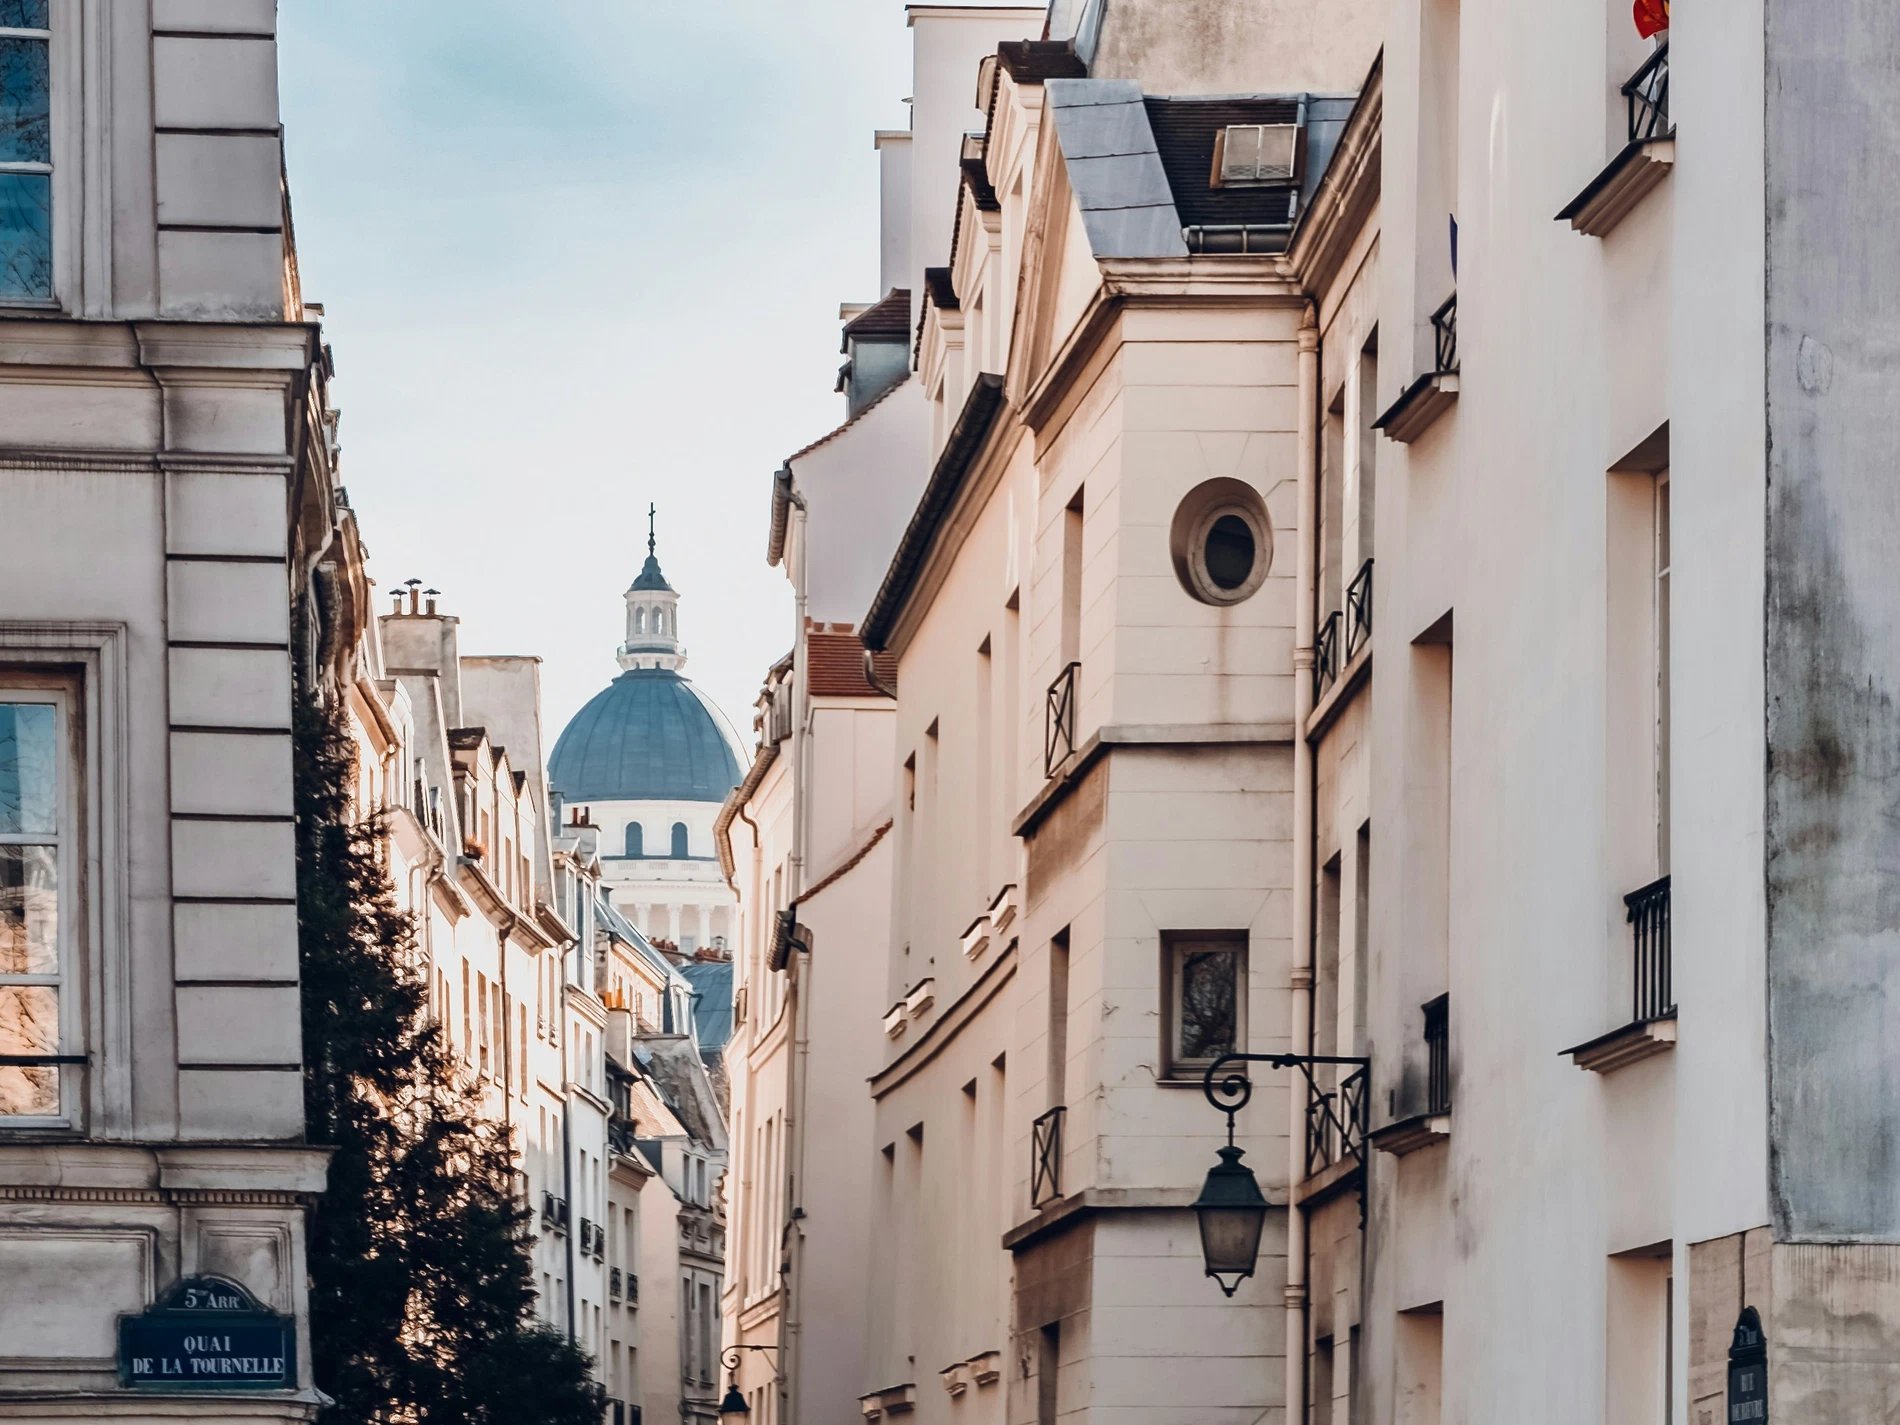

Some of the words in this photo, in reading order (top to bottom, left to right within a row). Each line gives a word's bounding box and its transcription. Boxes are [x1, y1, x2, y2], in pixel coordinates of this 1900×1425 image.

[184, 1336, 231, 1354] QUAI
[132, 1358, 154, 1374] DE
[161, 1358, 183, 1374] LA
[190, 1357, 284, 1375] TOURNELLE
